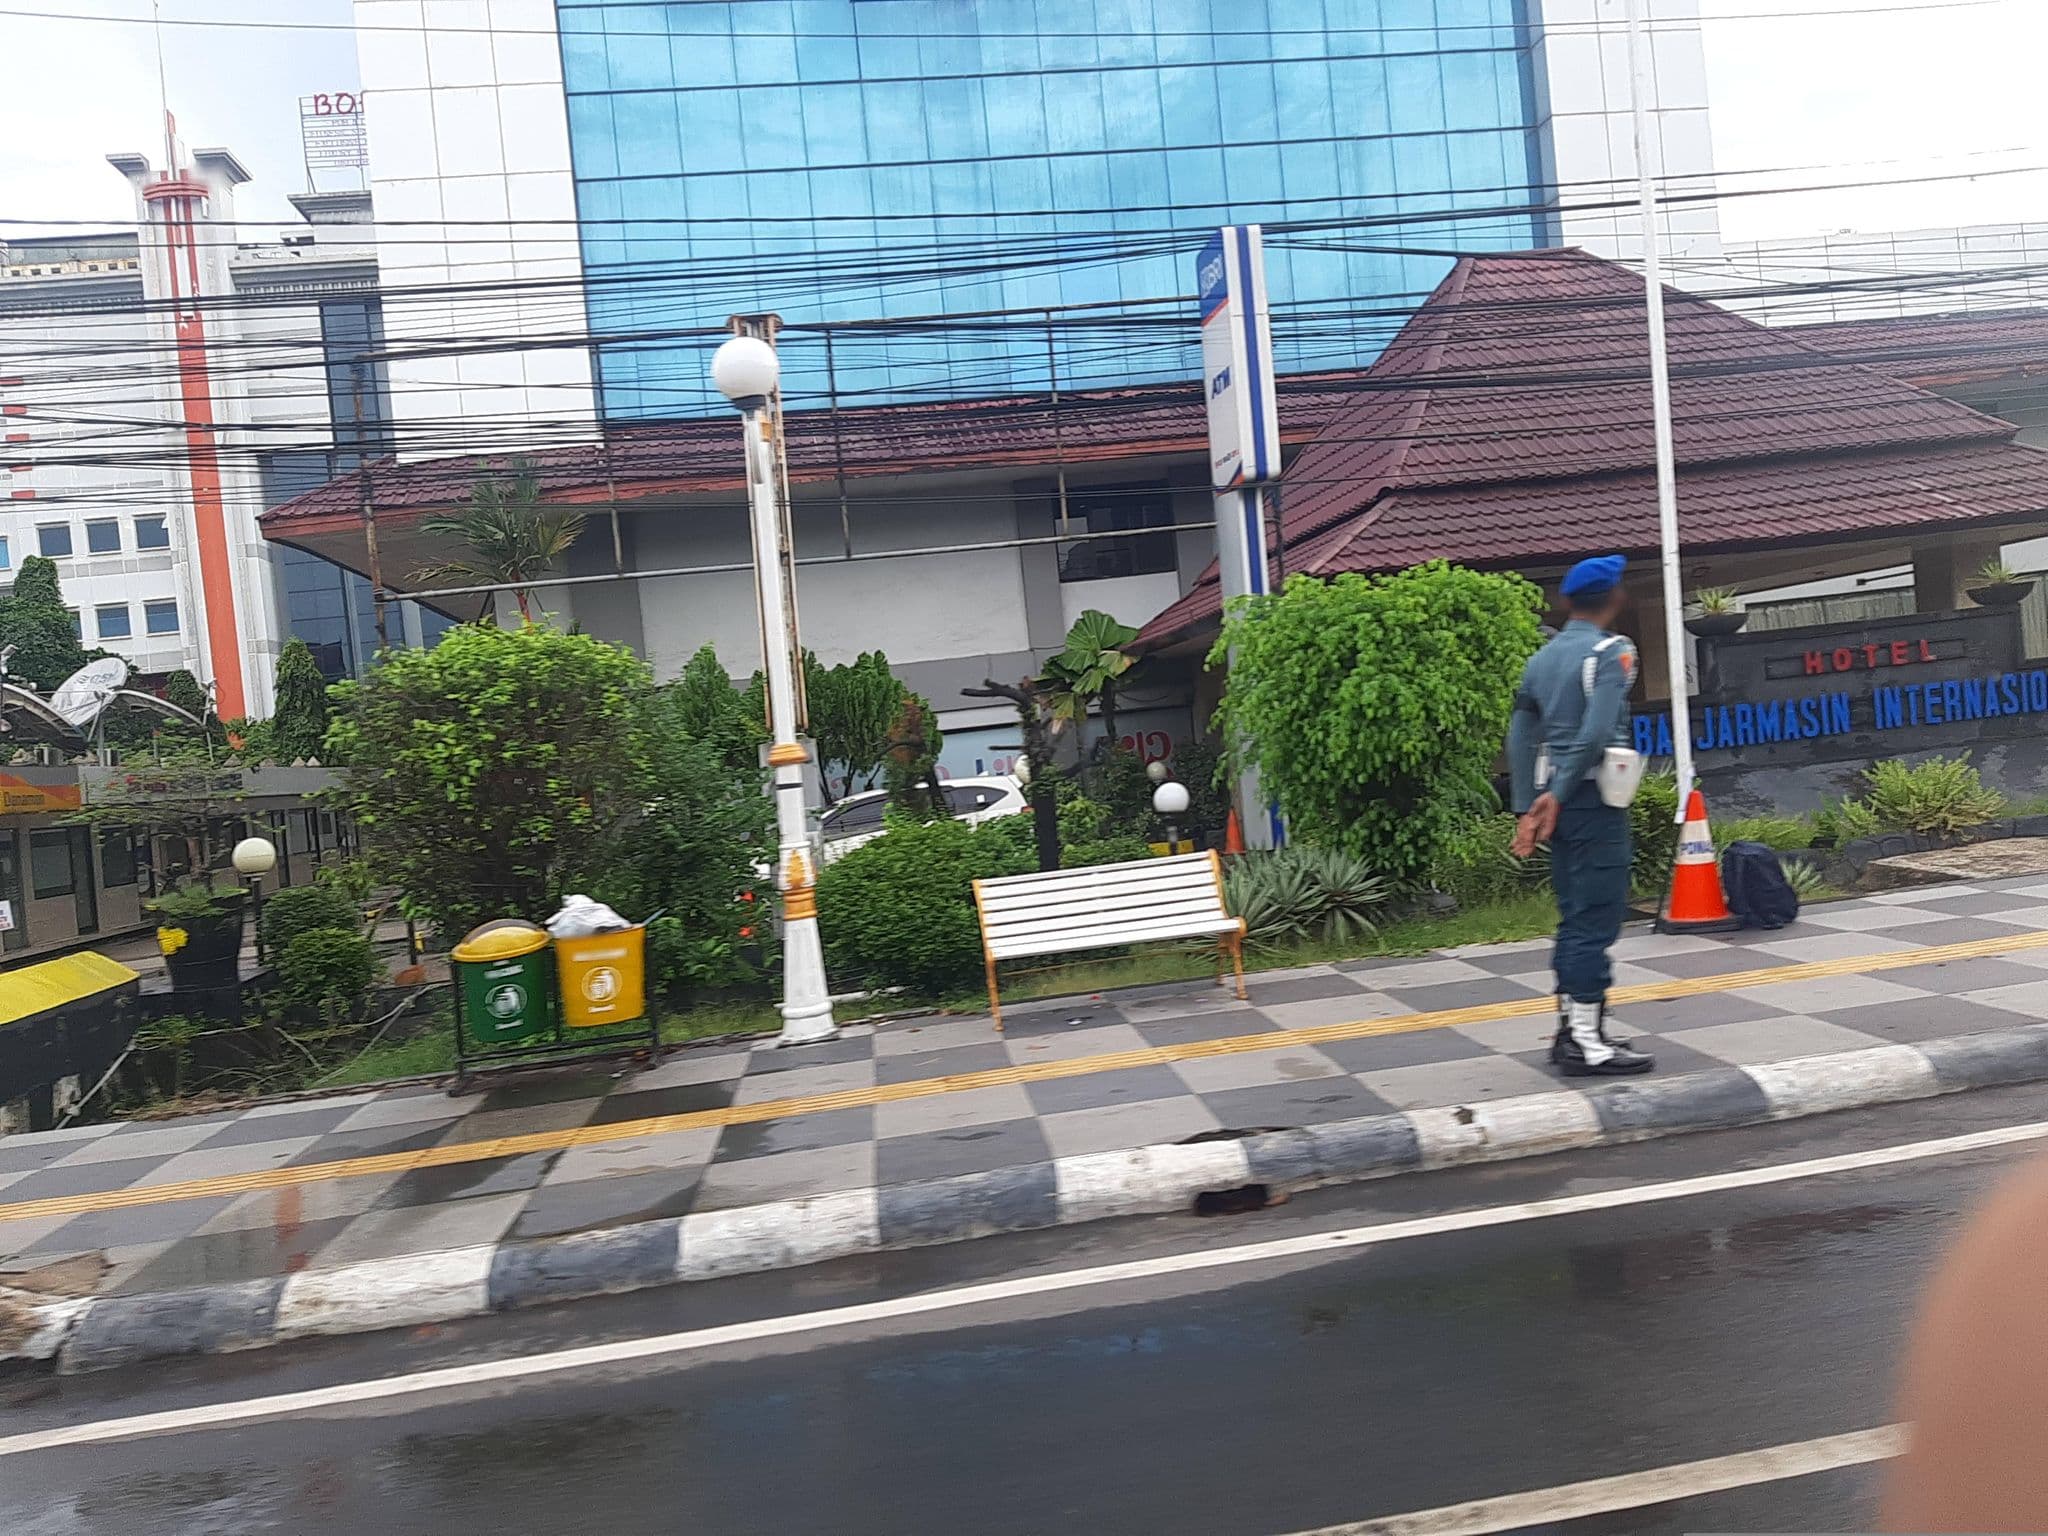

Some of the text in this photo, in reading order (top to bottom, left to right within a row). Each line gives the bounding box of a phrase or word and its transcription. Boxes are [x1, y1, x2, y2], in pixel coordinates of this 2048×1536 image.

[1211, 366, 1231, 399] ATM
[1803, 639, 1937, 675] HOTEL
[1632, 691, 1852, 757] BAJARMASIN
